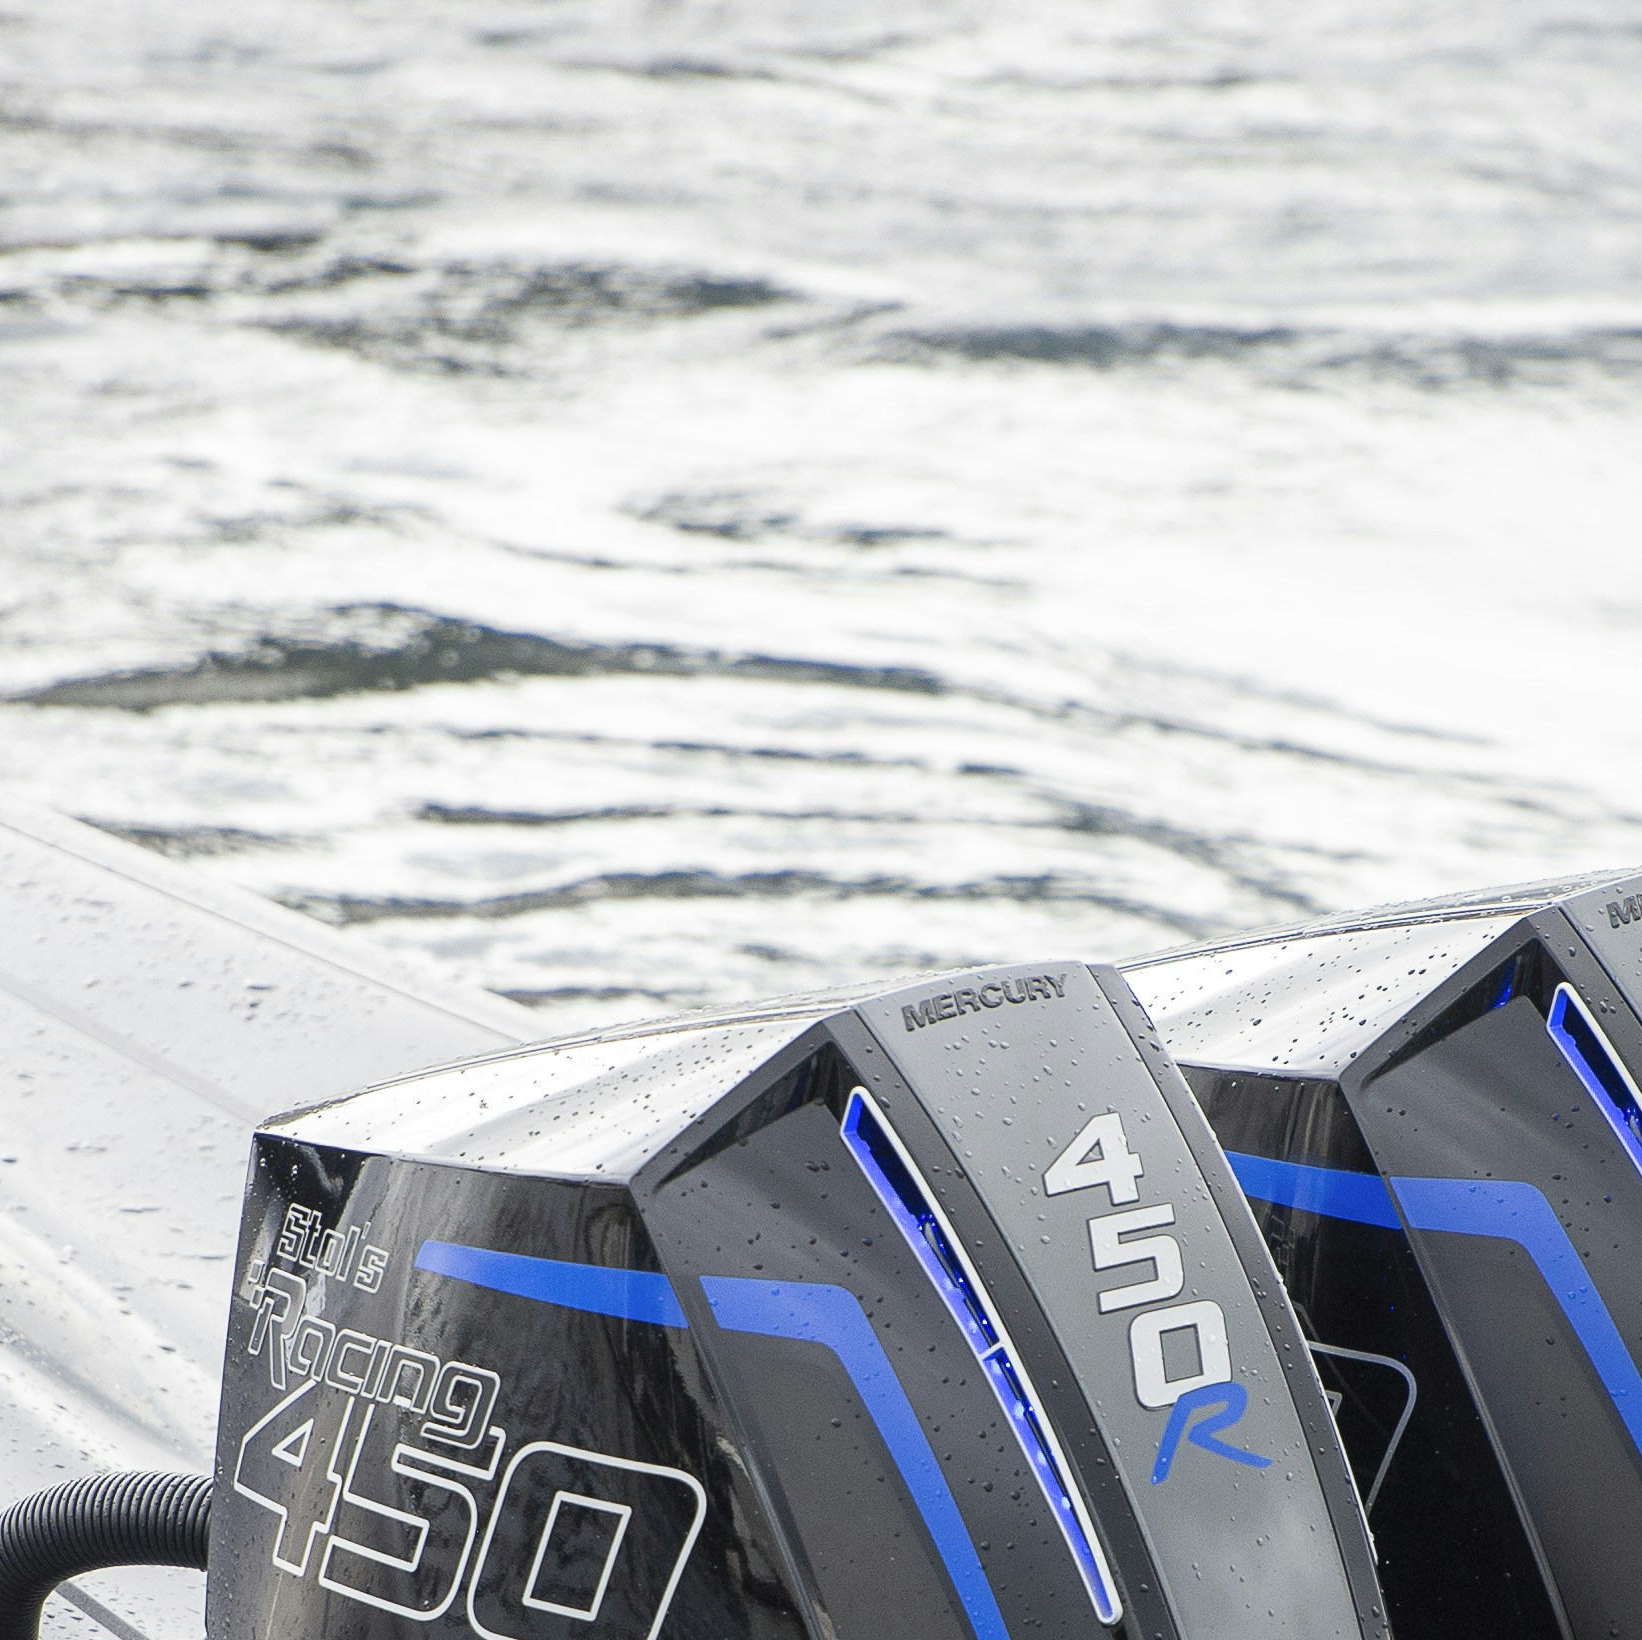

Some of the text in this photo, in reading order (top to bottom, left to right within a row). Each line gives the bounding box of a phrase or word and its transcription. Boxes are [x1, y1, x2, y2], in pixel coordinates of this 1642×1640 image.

[901, 972, 1068, 1032] MERCURY
[277, 1203, 389, 1294] Stol's
[246, 1260, 501, 1449] Racing
